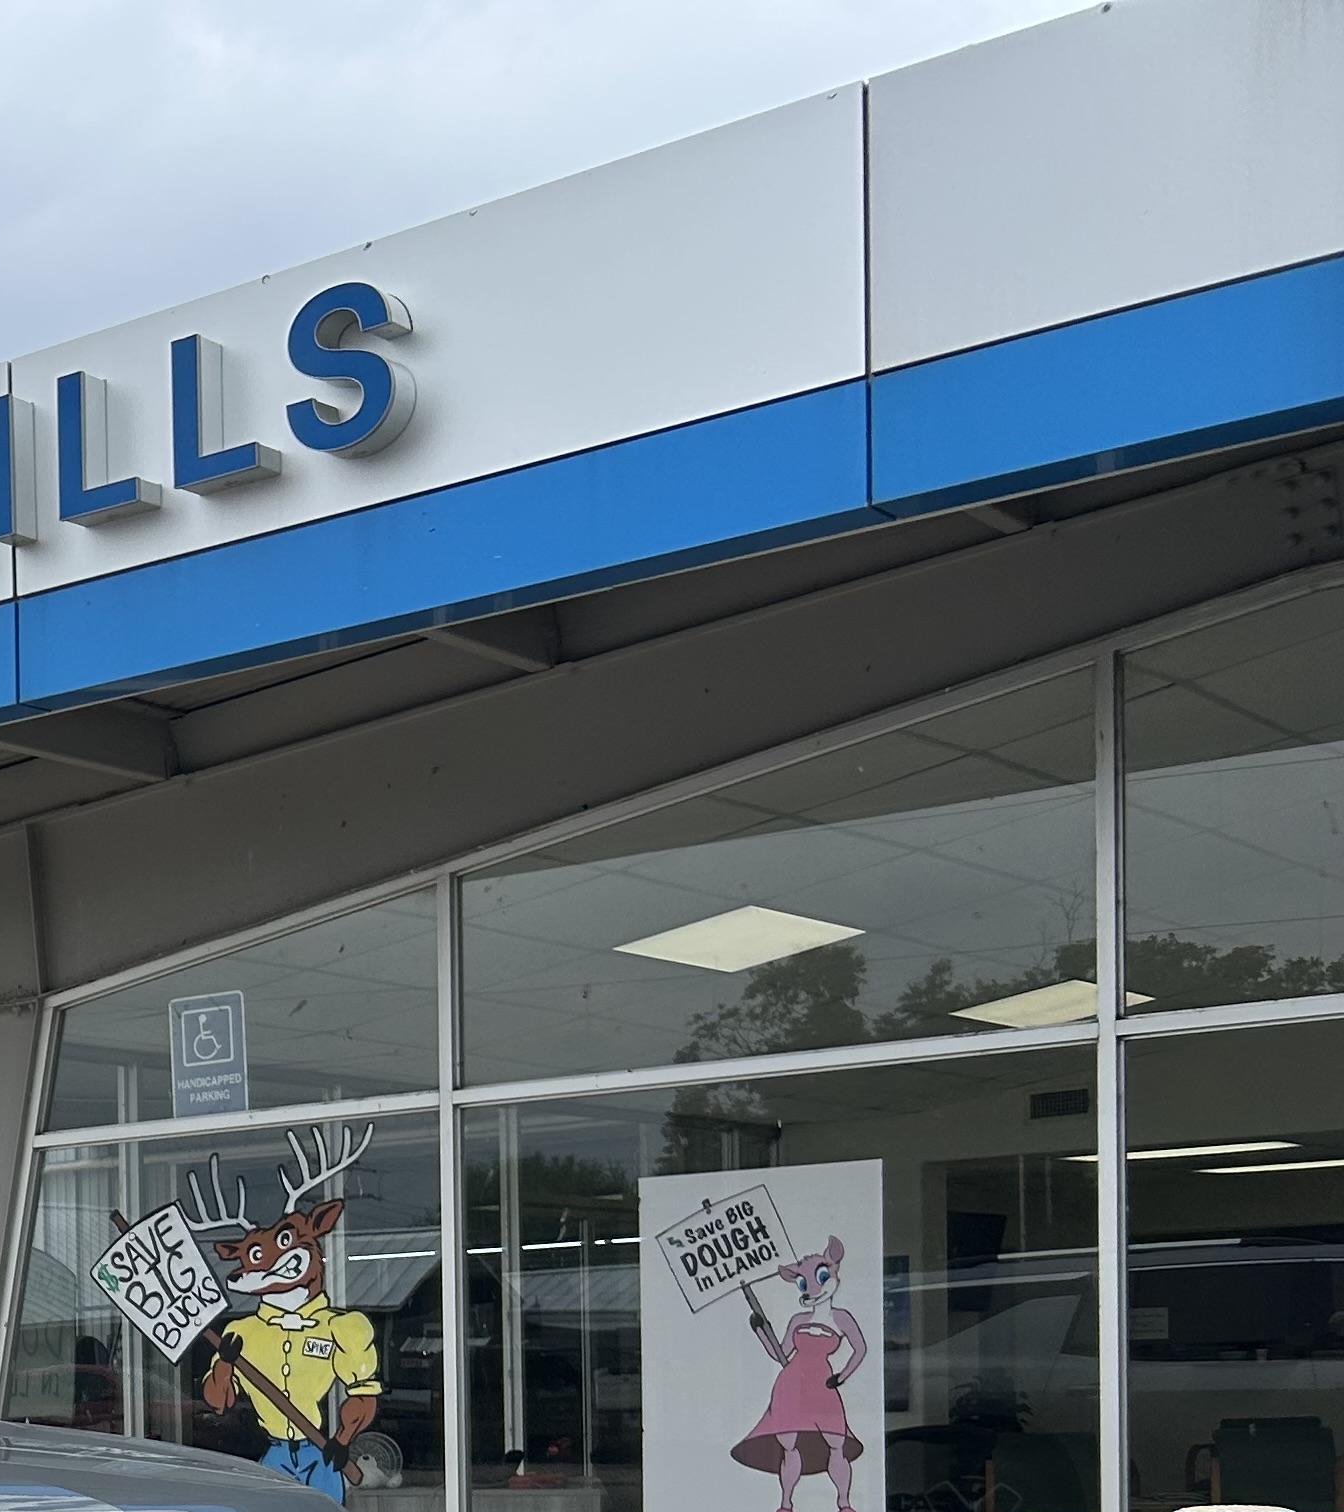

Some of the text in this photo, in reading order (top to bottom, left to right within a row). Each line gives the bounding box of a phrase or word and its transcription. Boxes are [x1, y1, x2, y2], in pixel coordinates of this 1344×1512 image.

[177, 1072, 243, 1089] HANDICAPPED
[189, 1088, 231, 1104] PARKING
[684, 1218, 725, 1244] Save
[725, 1201, 754, 1225] BIG
[680, 1216, 770, 1277] DOUGH
[713, 1240, 780, 1283] LLANO!
[125, 1250, 196, 1319] BIG
[152, 1276, 221, 1349] BUCKS
